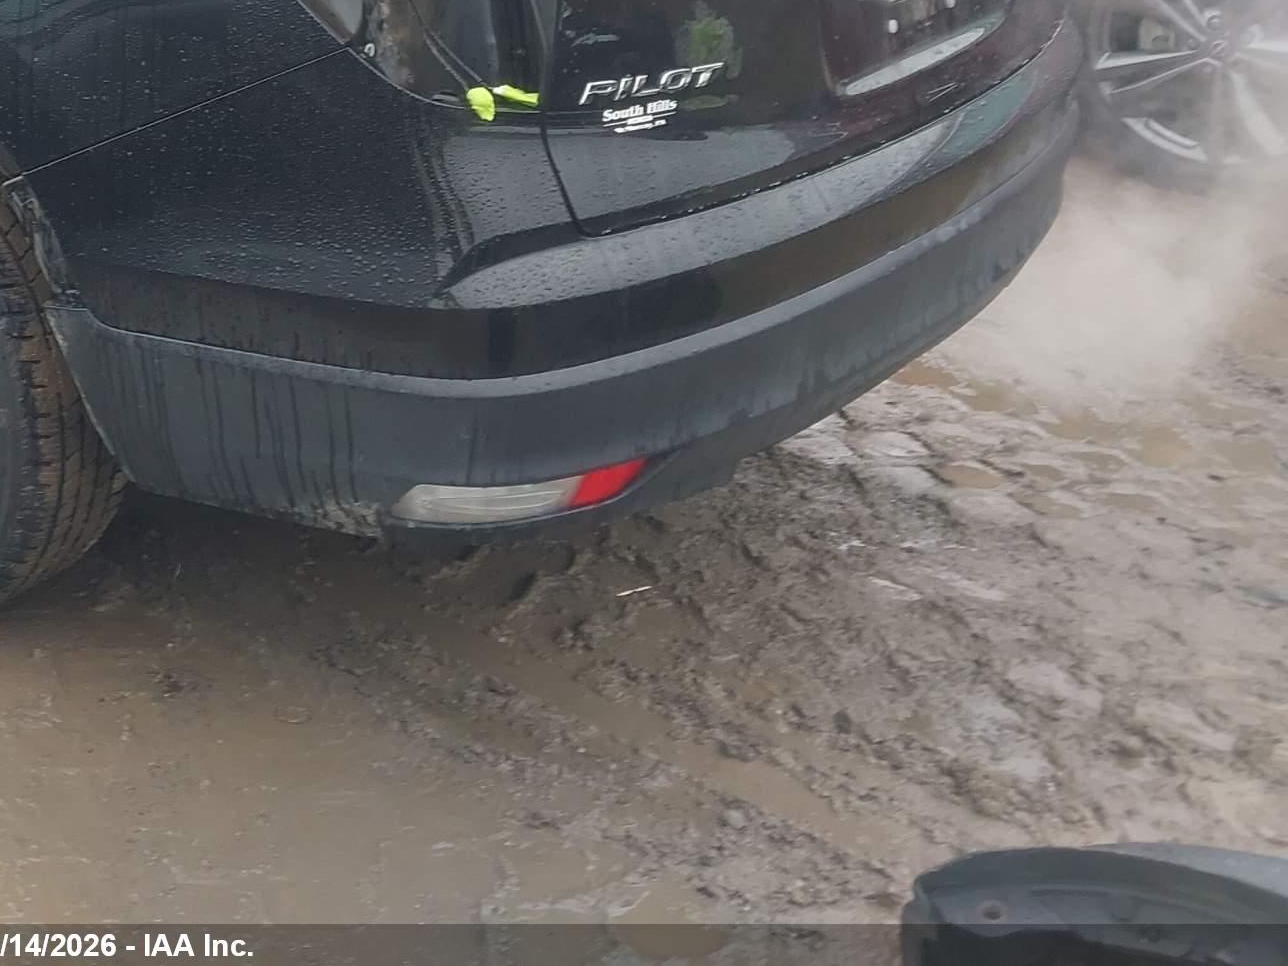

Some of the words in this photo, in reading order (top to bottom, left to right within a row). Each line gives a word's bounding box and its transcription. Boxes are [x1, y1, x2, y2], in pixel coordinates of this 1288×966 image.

[579, 62, 724, 105] PILOT
[602, 105, 644, 122] South
[646, 99, 678, 114] Hills
